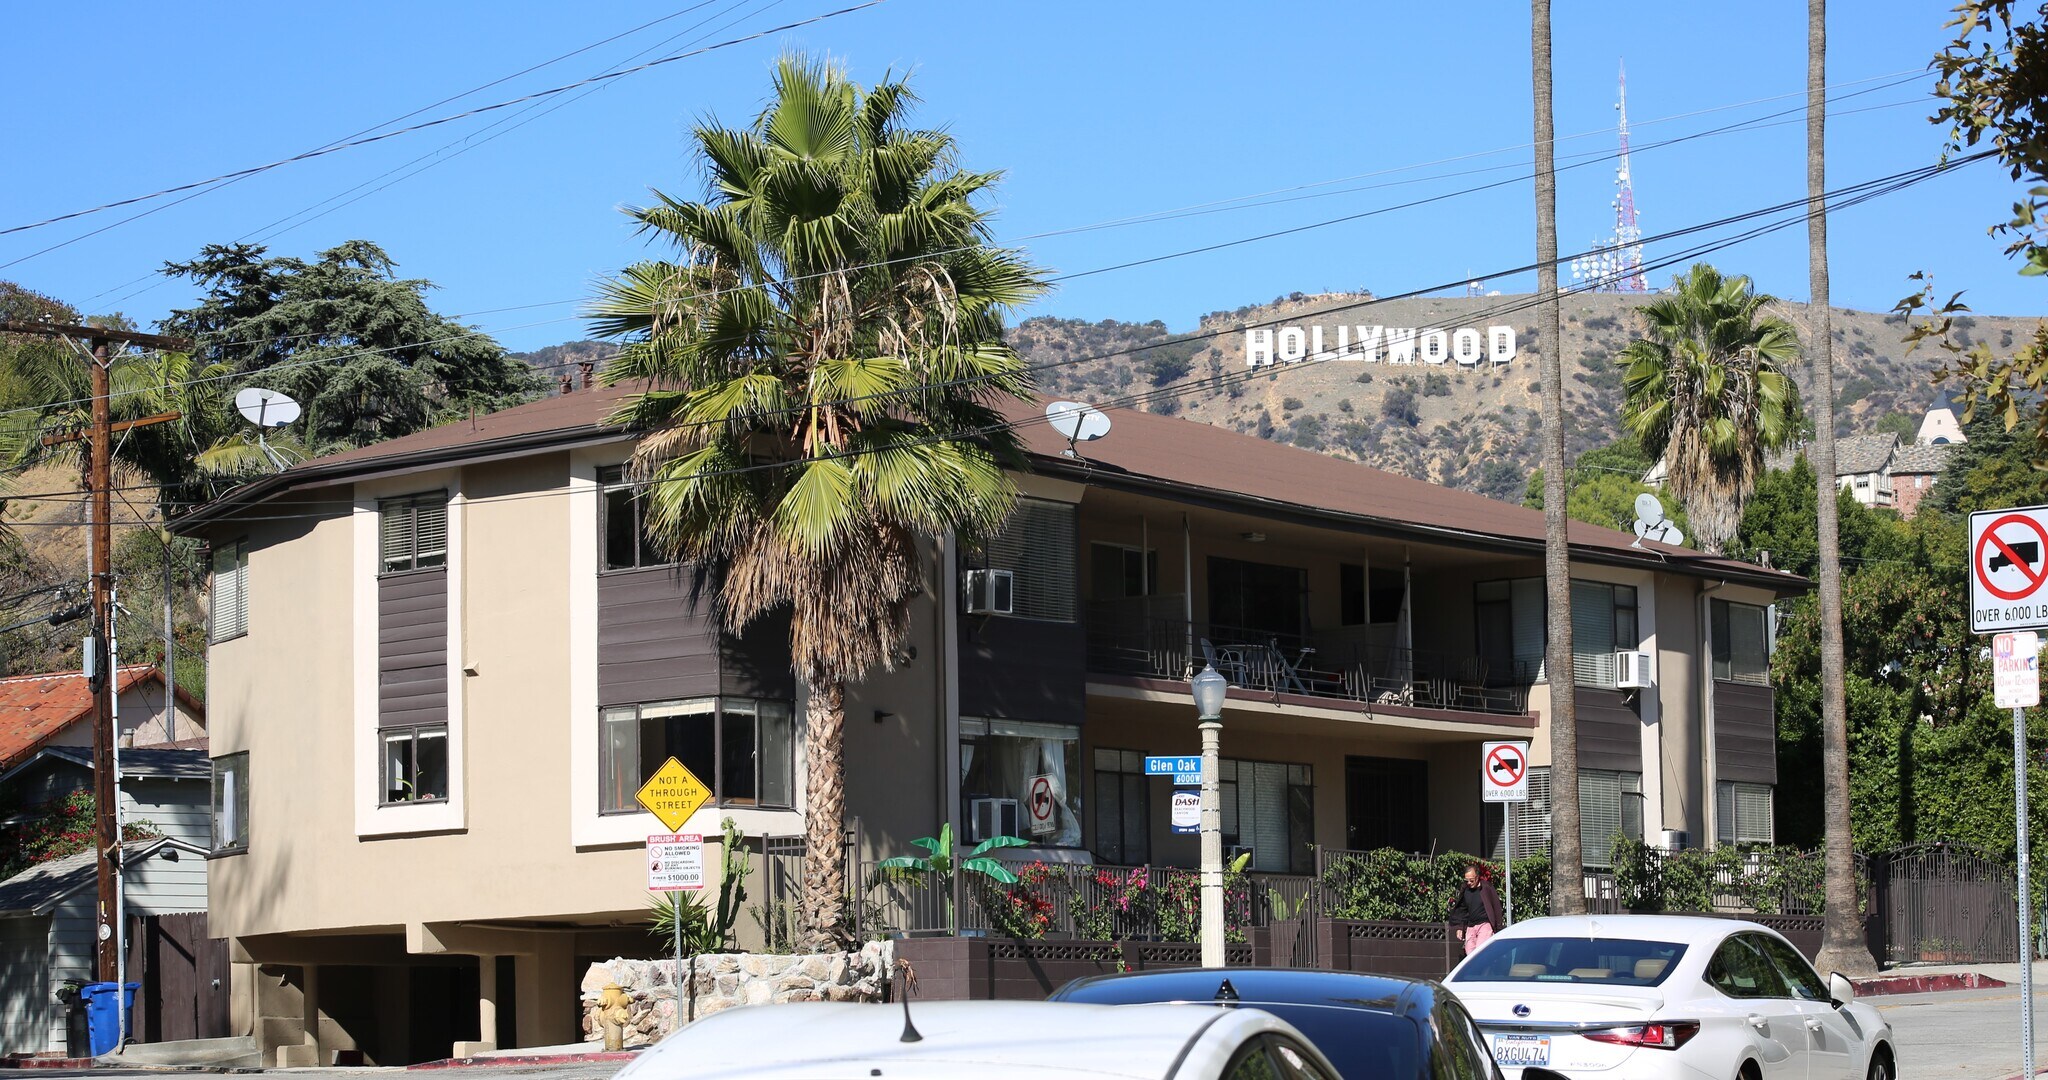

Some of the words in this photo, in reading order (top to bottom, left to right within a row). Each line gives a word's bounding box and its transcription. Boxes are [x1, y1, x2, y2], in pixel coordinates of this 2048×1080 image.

[1246, 325, 1516, 366] HOLLYWOOD
[1976, 608, 2000, 623] OVER
[2004, 605, 2031, 622] 6,000
[2036, 604, 2048, 618] LB
[1996, 637, 2012, 654] NO
[1999, 657, 2038, 672] PARKIN
[1150, 759, 1173, 772] Glen
[1177, 758, 1196, 772] Oak
[659, 776, 678, 785] NOT
[682, 776, 688, 784] A
[1176, 774, 1201, 783] 6000W
[650, 788, 697, 798] THROUGH
[656, 801, 692, 810] STREET
[1175, 798, 1200, 806] DASH
[1496, 1046, 1545, 1061] 8XGU474
